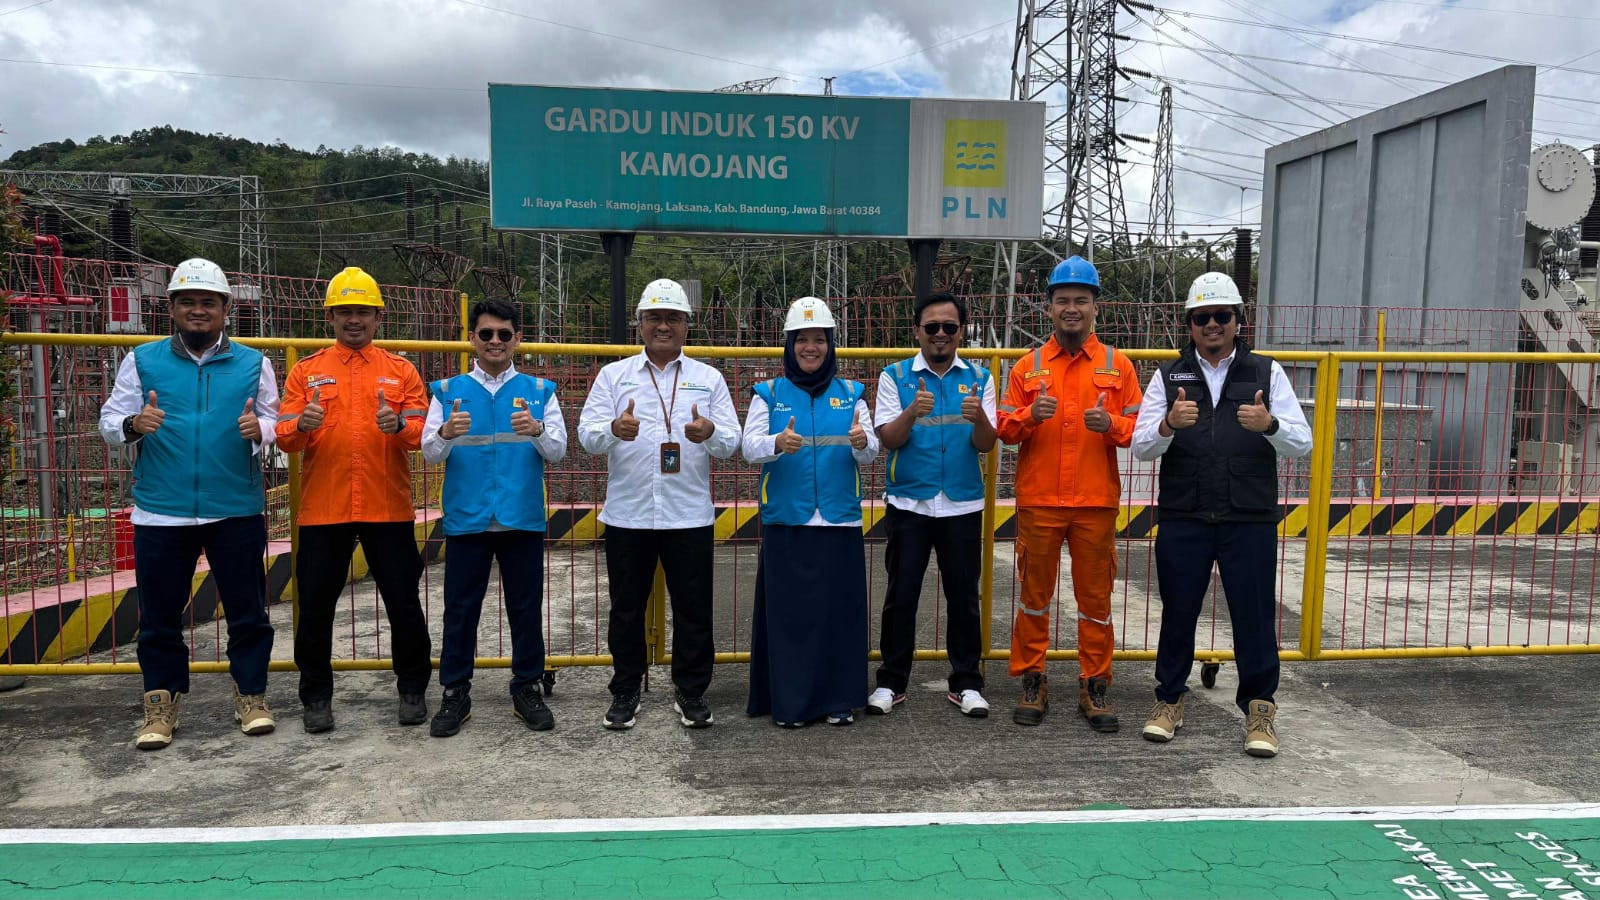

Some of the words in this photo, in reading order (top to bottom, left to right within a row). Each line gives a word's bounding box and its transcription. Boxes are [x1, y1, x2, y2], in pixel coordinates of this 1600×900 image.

[544, 106, 652, 135] GARDU
[661, 111, 756, 138] INDUK
[764, 114, 814, 140] 150
[822, 115, 860, 141] KV
[620, 151, 788, 180] KAMOJANG
[521, 197, 534, 208] Jl.
[536, 198, 562, 210] Raya
[565, 198, 597, 209] Paseh
[605, 199, 664, 213] Kamojang,
[666, 201, 712, 213] Laksana,
[715, 203, 738, 213] Kab.
[740, 203, 789, 216] Bandung,
[792, 204, 817, 215] Jawa
[820, 205, 847, 215] Barat
[850, 205, 881, 215] 40384
[943, 197, 1007, 219] PLN
[1461, 859, 1543, 900] MET
